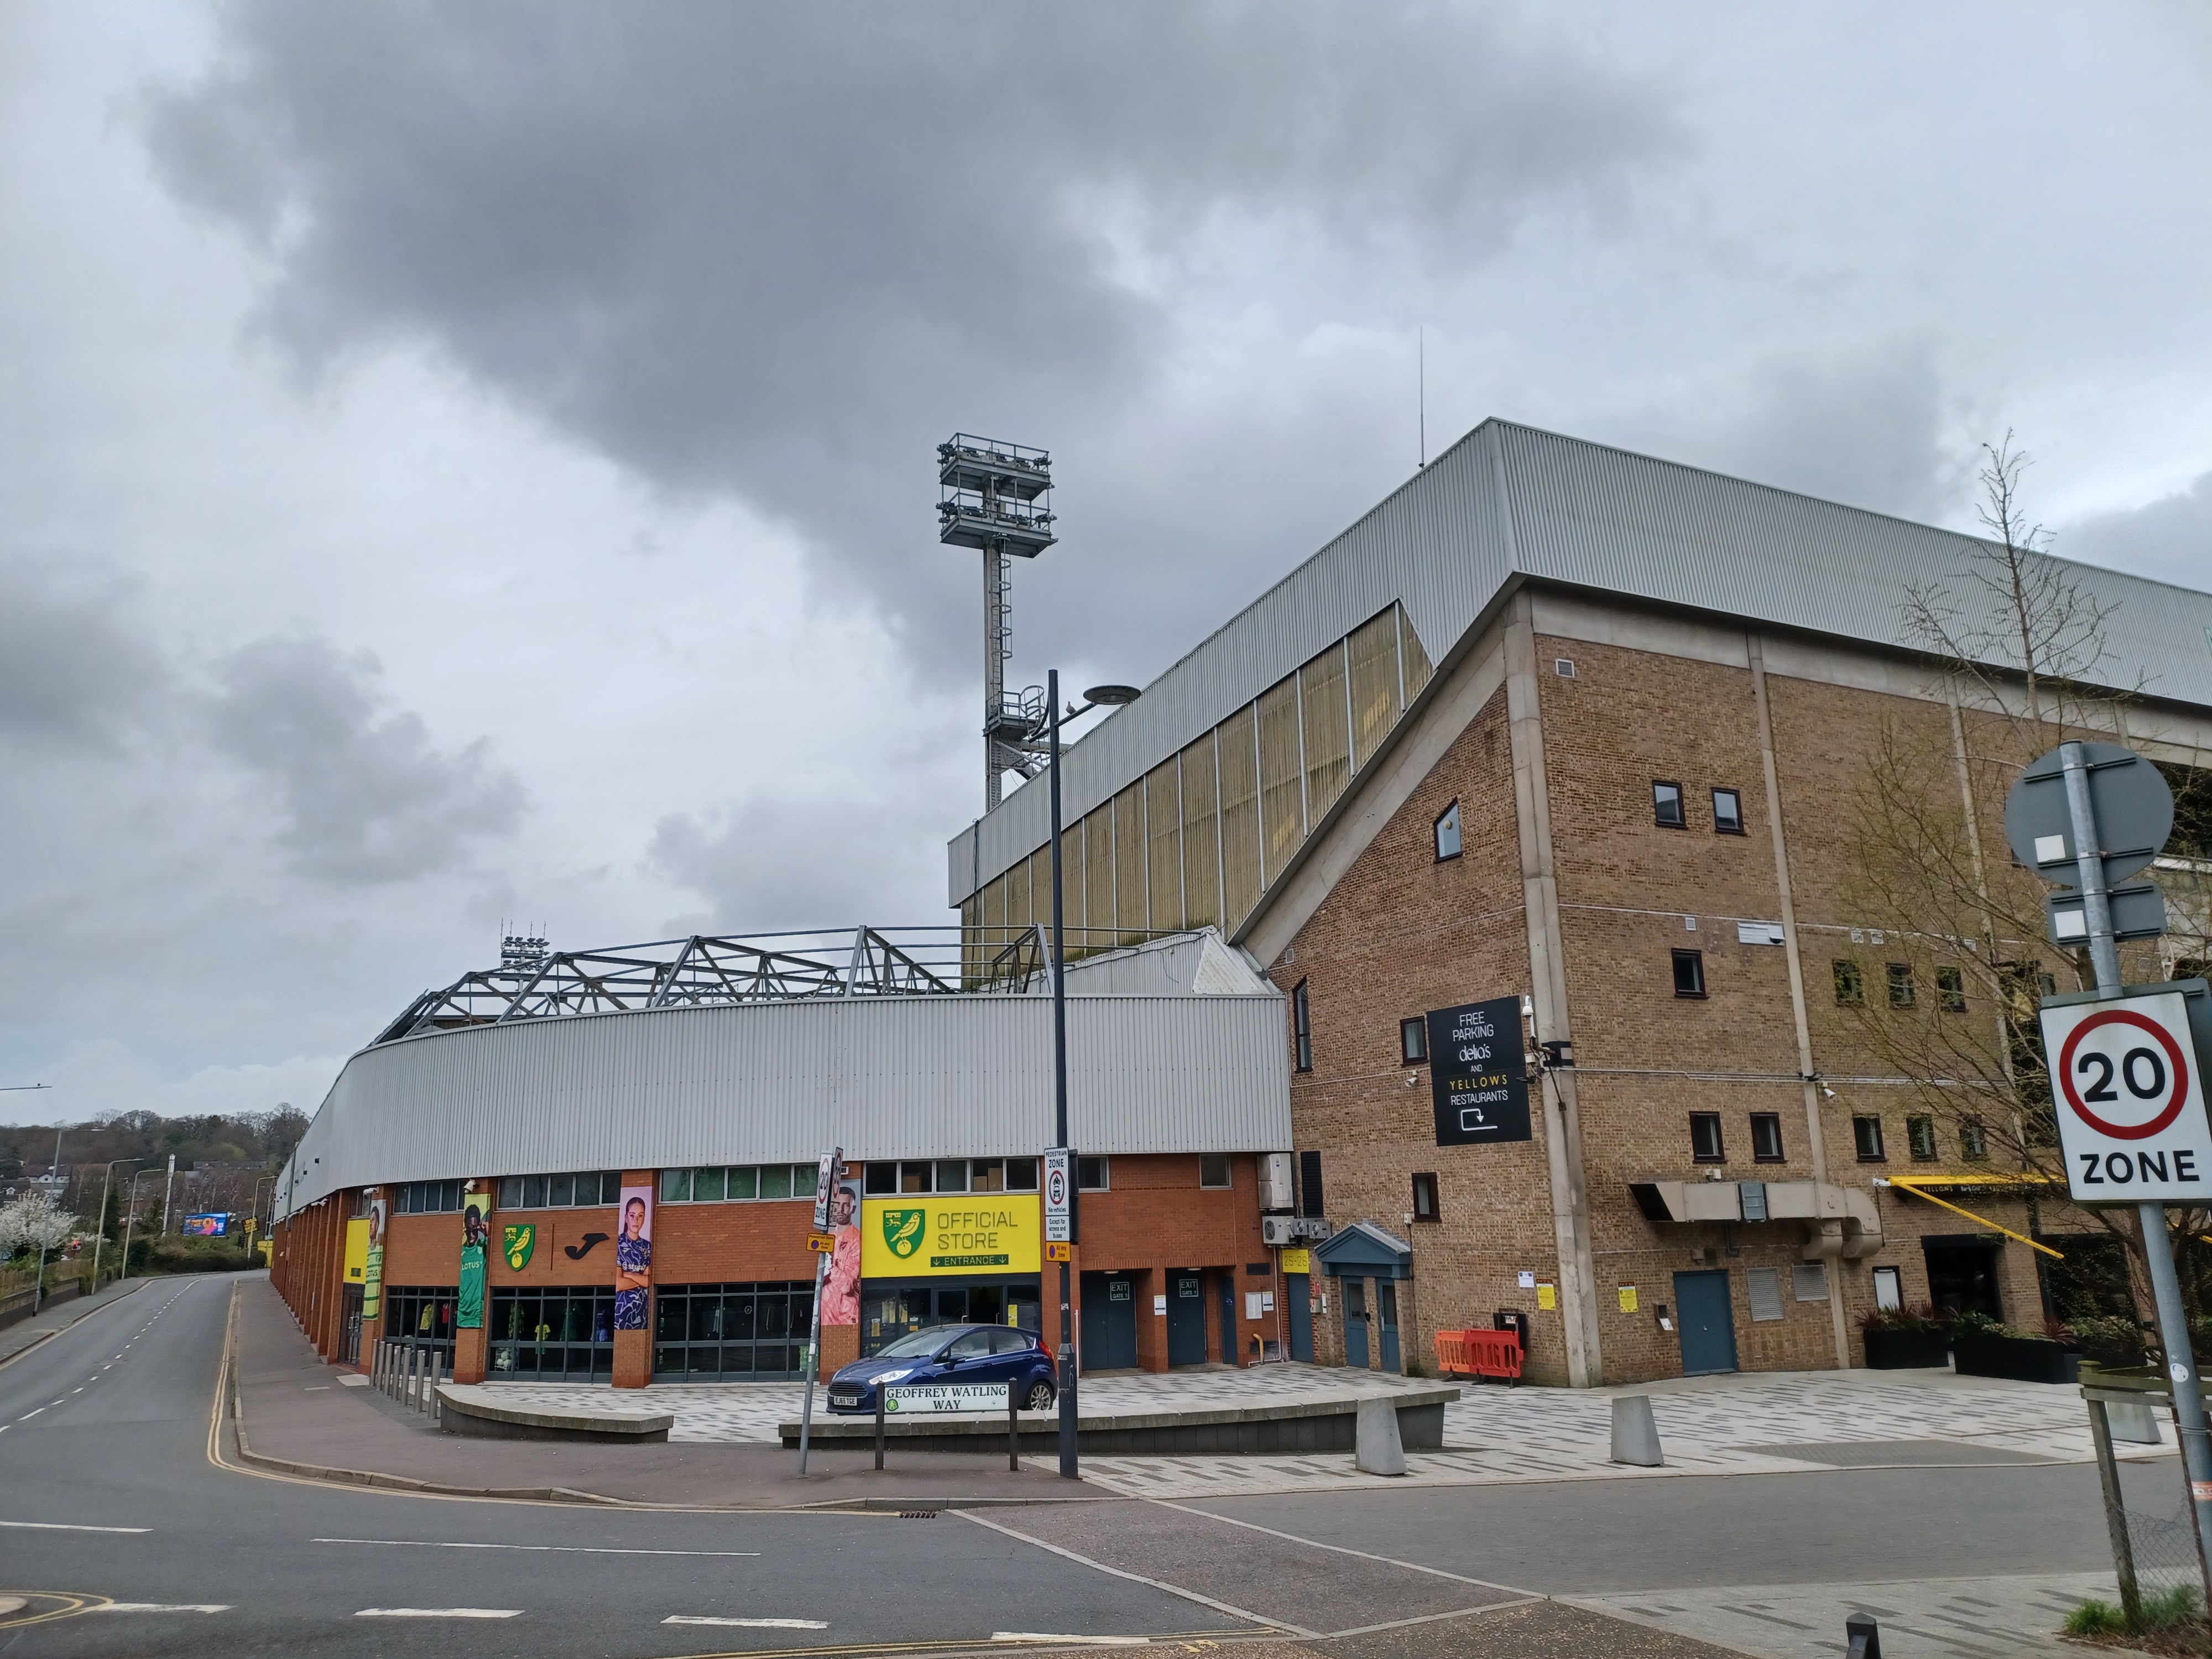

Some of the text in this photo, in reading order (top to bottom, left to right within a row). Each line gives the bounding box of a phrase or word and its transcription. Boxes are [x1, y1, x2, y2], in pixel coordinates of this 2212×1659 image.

[1459, 1011, 1485, 1027] FREE
[1453, 1024, 1494, 1042] PARKING
[1459, 1044, 1491, 1062] delia's
[1470, 1064, 1483, 1072] AND
[2078, 1047, 2166, 1102] 20
[1449, 1074, 1507, 1091] YELLOWS
[1451, 1089, 1508, 1105] RESTAURANTS
[1048, 1159, 1064, 1168] ZONE
[2080, 1150, 2200, 1184] ZONE
[820, 1171, 828, 1190] 20
[816, 1207, 825, 1219] ZONE
[938, 1211, 1018, 1229] OFFICIAL
[938, 1232, 998, 1250] STORE
[462, 1261, 480, 1271] LOTUS
[945, 1256, 995, 1266] ENTRANCE
[1284, 1256, 1307, 1266] 25-26
[886, 1386, 1007, 1399] GEOFFREY WATLING
[933, 1400, 961, 1410] WAY
